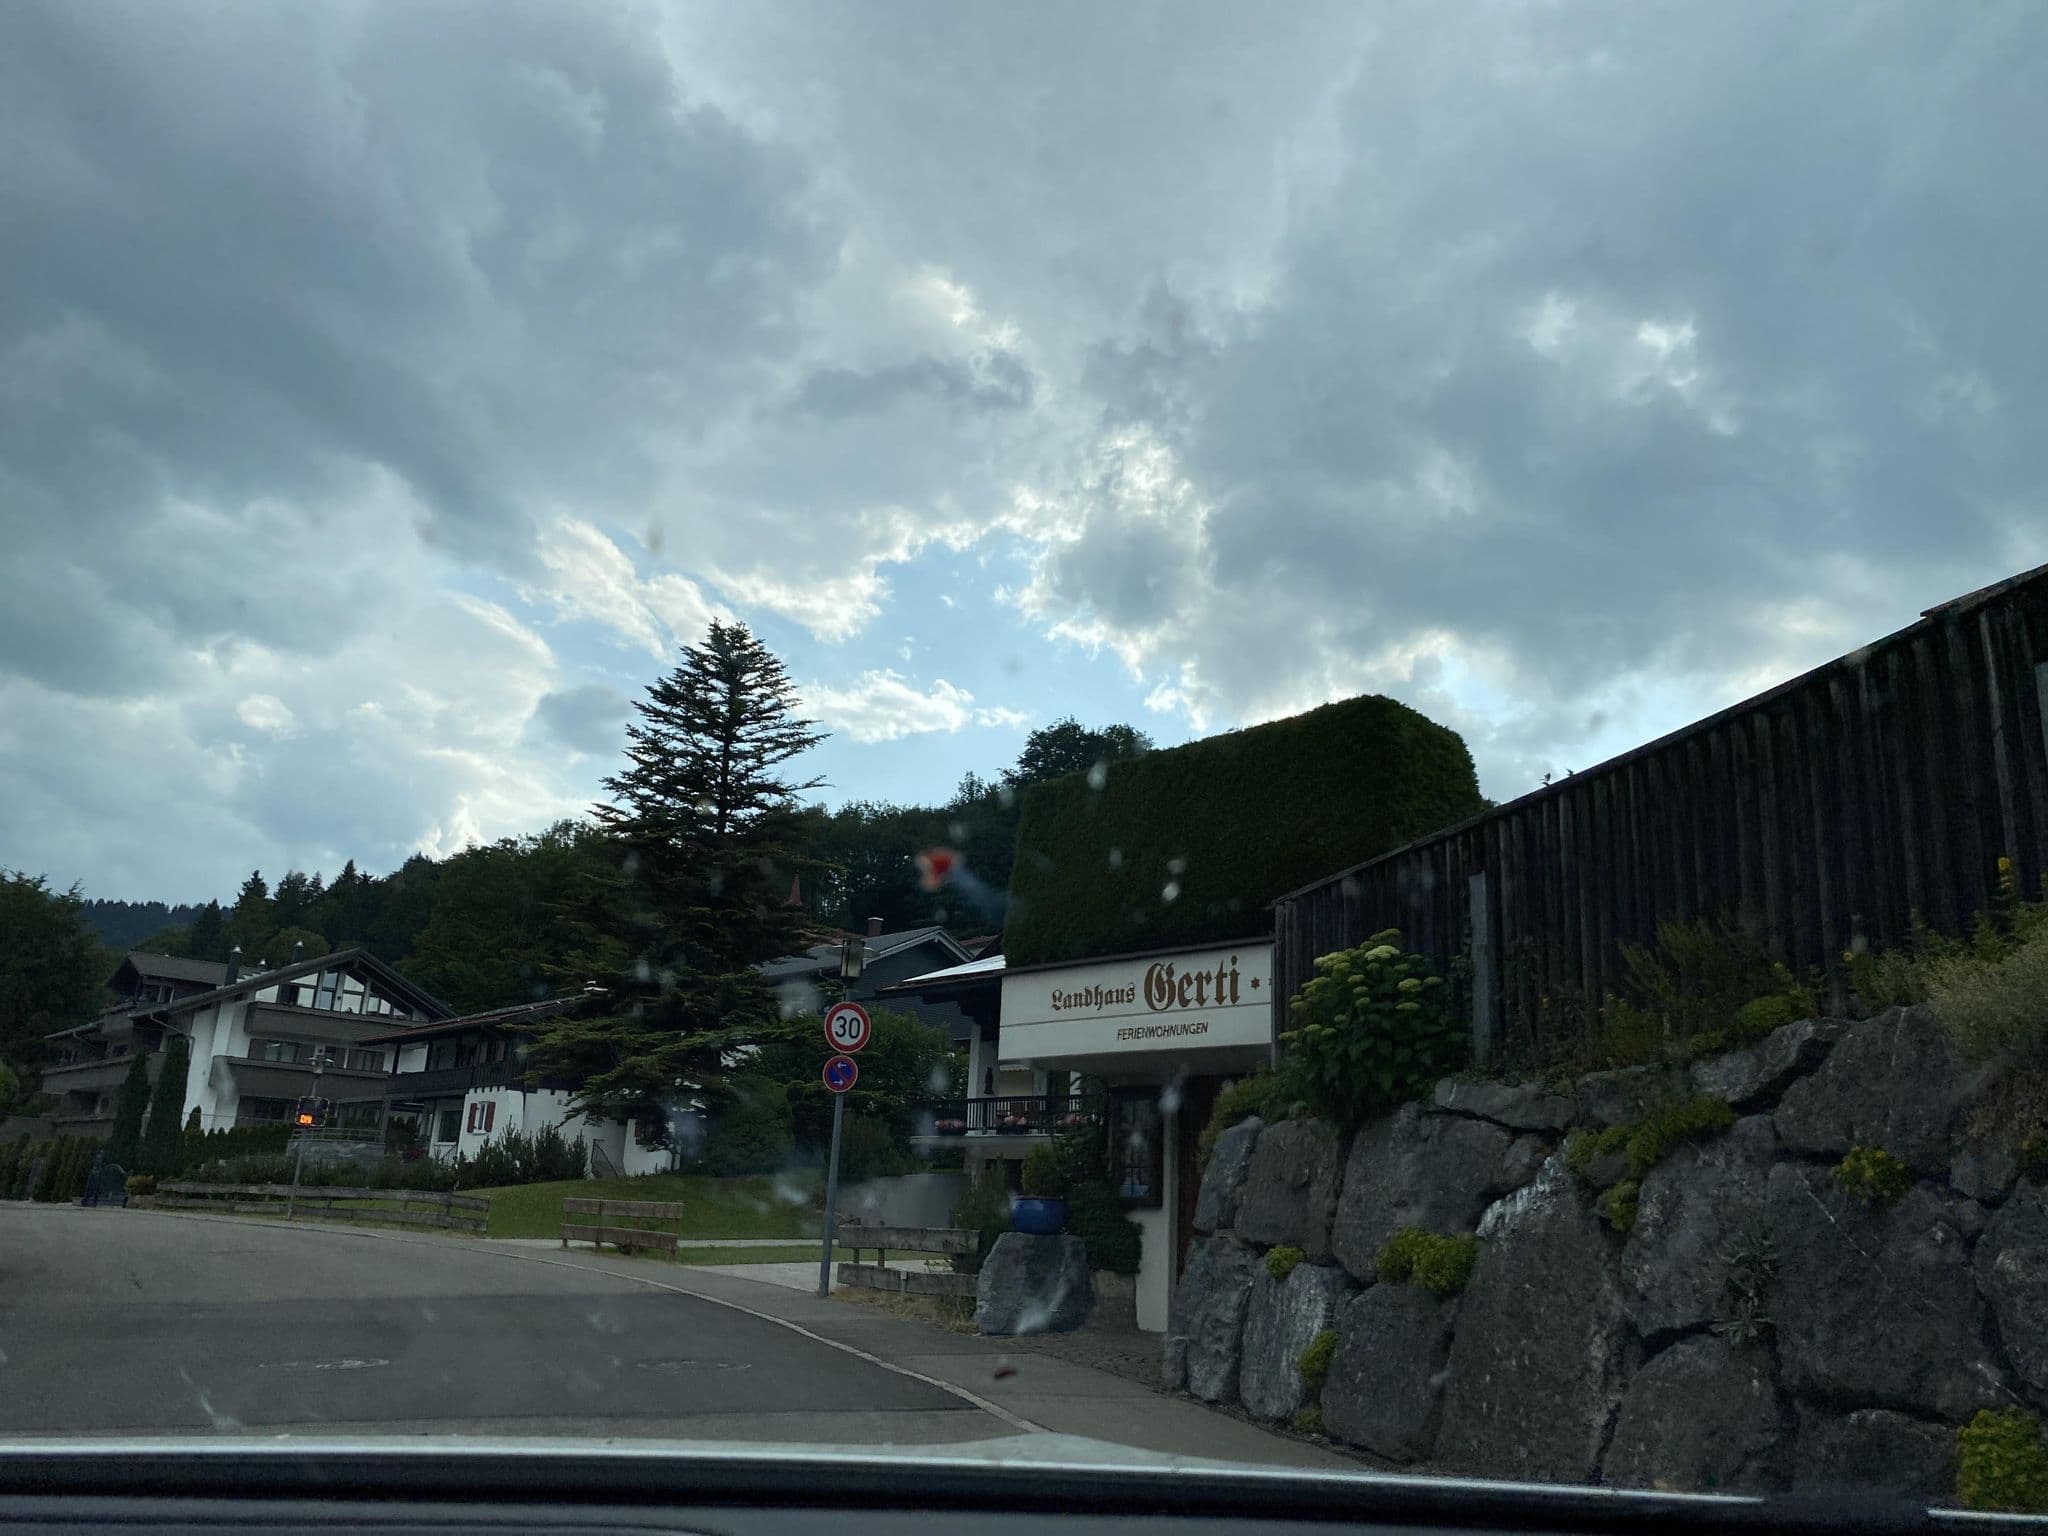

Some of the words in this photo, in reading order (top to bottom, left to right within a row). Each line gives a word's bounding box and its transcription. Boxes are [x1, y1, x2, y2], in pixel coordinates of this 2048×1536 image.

[1051, 982, 1136, 1011] Landhaus
[1144, 955, 1240, 1011] Gerti
[834, 1015, 861, 1039] 30
[1116, 1022, 1209, 1041] FERIENWOHNUNGEN
